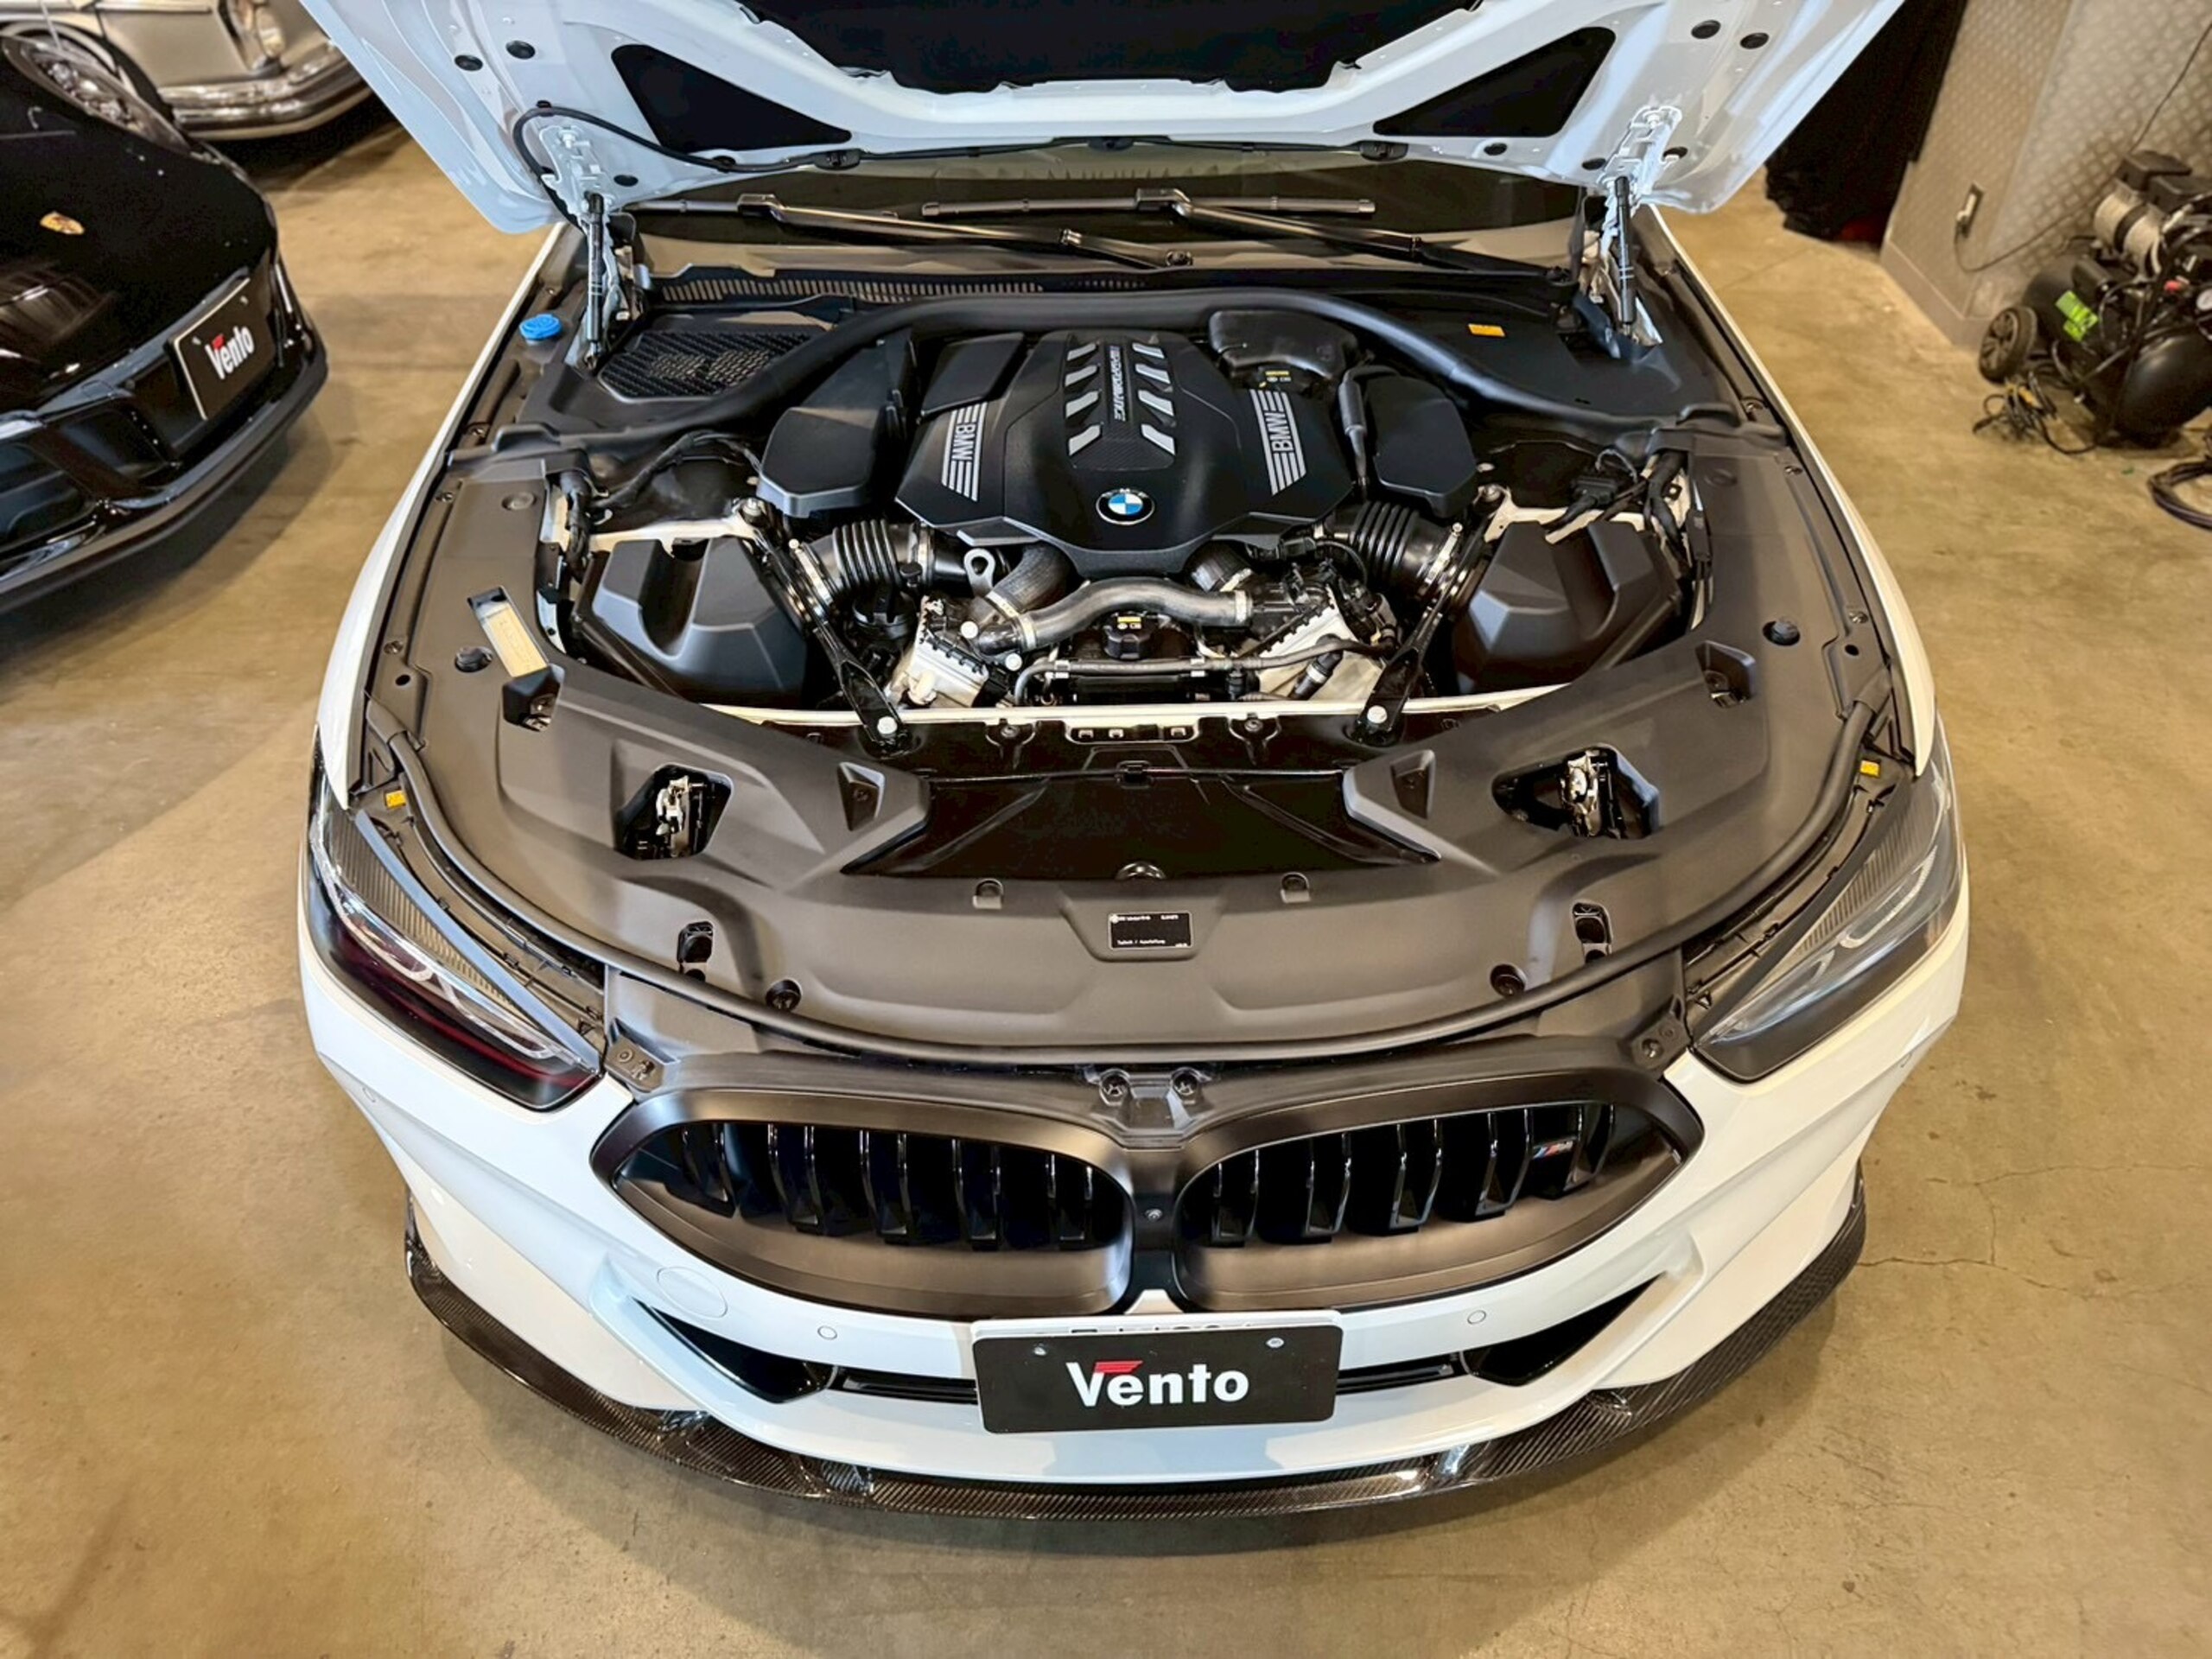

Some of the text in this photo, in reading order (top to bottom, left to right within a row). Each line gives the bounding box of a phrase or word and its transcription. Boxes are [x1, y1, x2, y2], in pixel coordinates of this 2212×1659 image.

[204, 326, 254, 379] Vento
[952, 423, 976, 461] BMW
[1264, 412, 1294, 452] BMW
[1065, 1360, 1249, 1407] Vento
